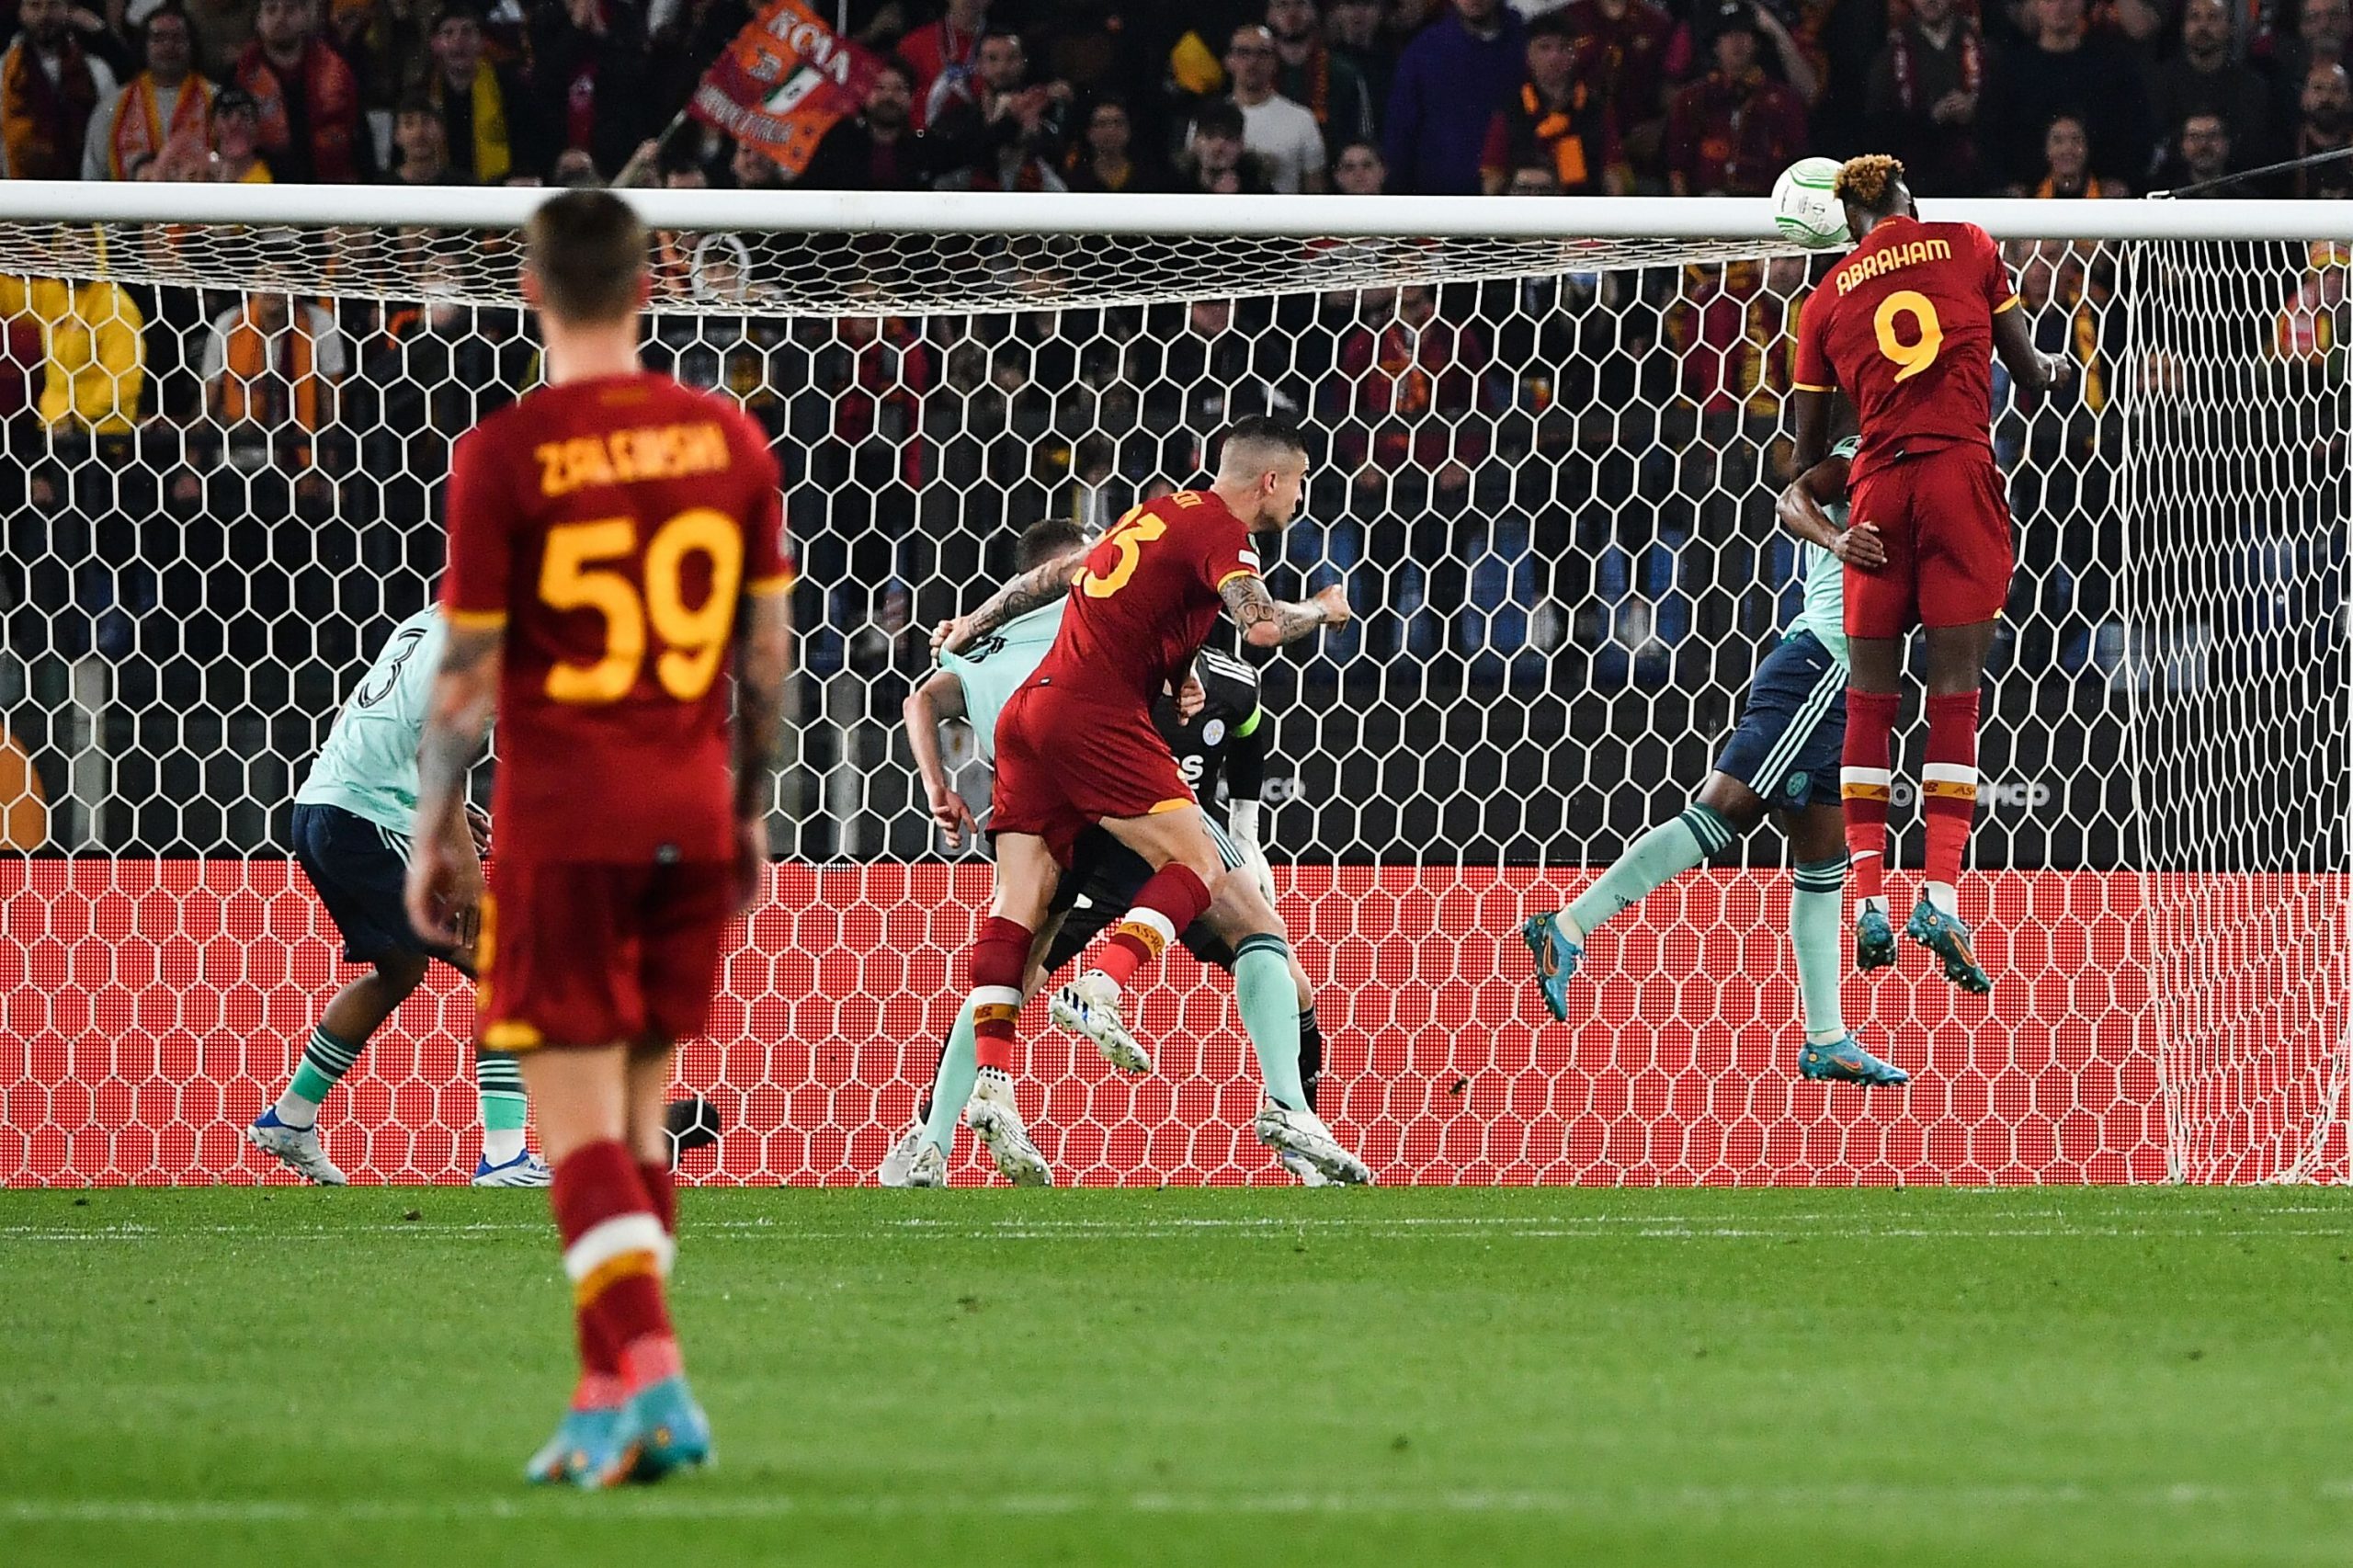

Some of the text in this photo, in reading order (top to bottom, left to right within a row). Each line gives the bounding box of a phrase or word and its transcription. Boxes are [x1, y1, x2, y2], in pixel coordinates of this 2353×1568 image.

[1836, 240, 1951, 296] ABRAHAM
[1874, 290, 1944, 383] 9
[538, 506, 745, 703] 59
[358, 628, 428, 709] 3
